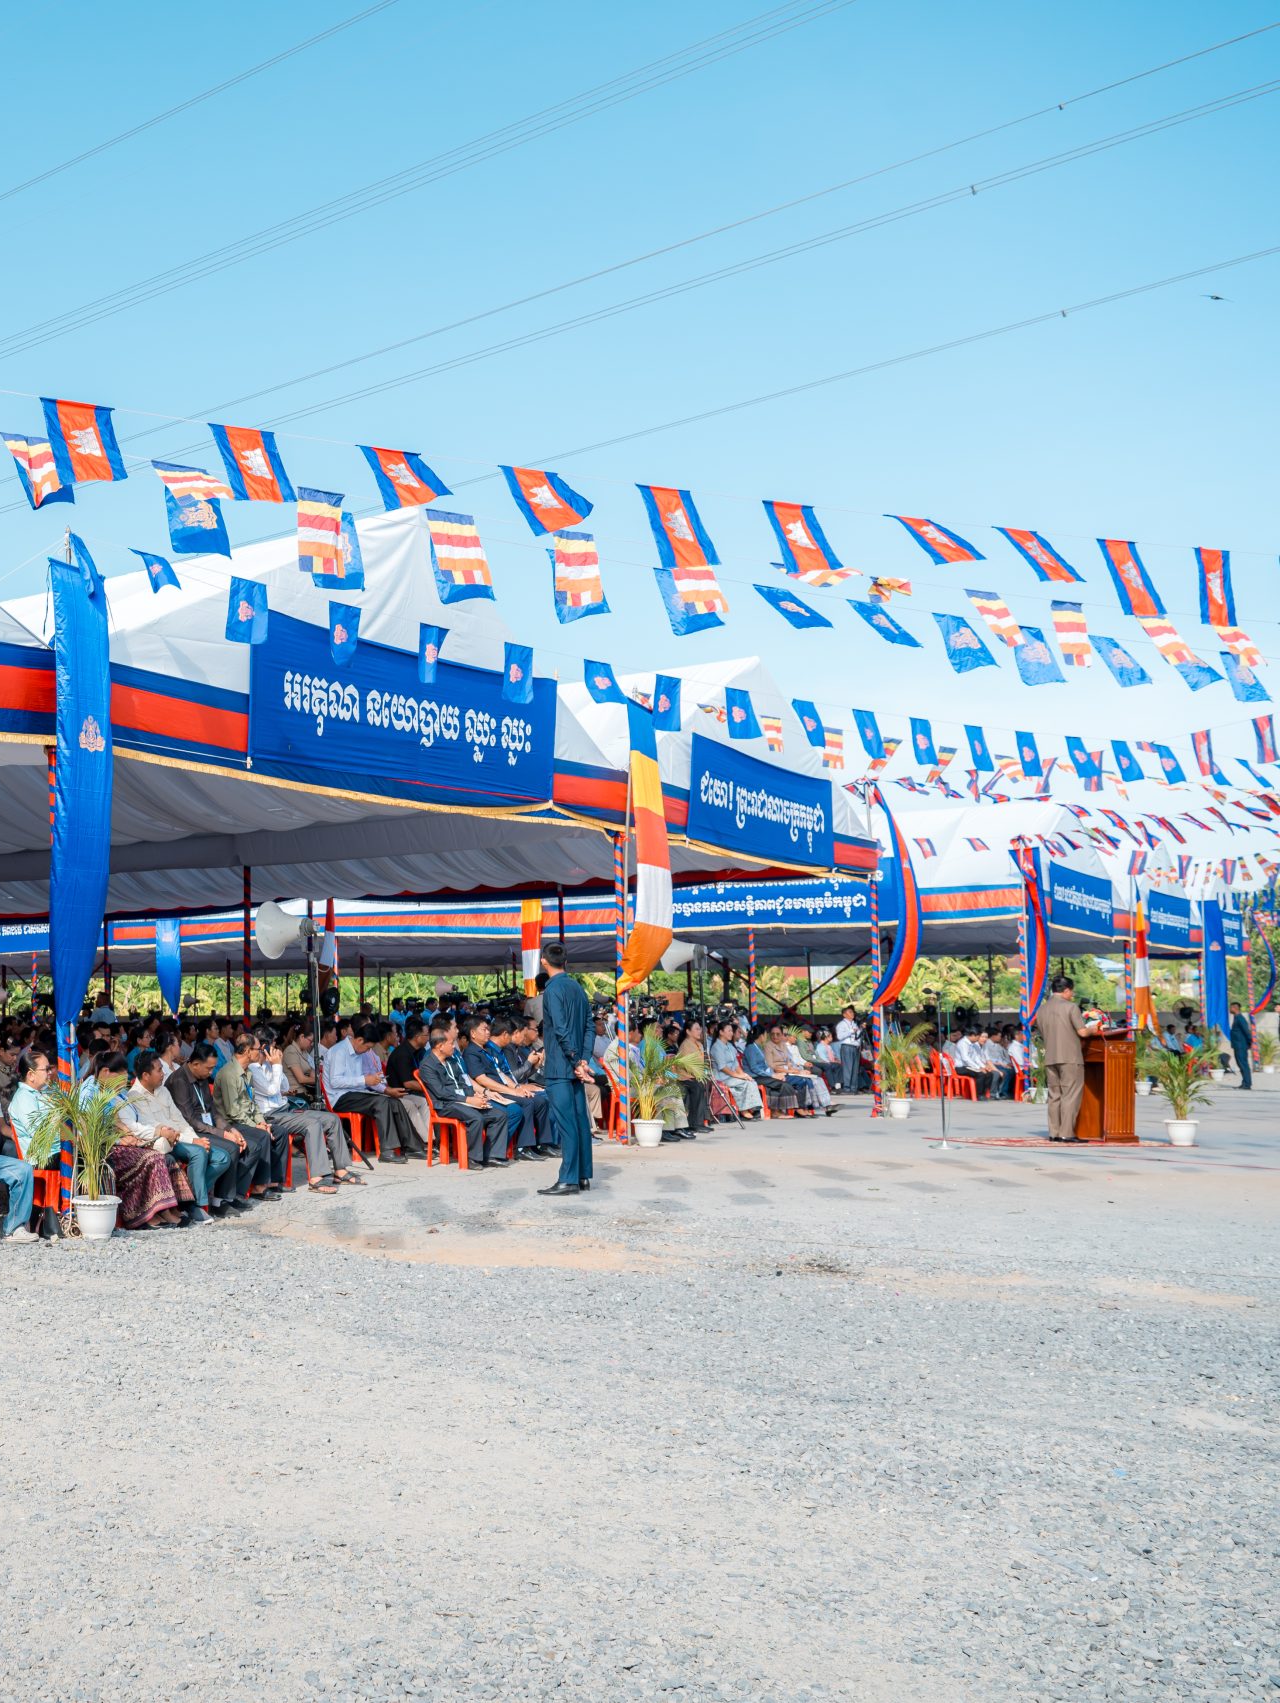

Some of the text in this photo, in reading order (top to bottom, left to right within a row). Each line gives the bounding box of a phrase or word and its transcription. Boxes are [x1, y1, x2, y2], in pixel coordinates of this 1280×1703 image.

[283, 670, 360, 737] អរគុណ
[366, 689, 460, 748] នយោបាយ
[672, 891, 867, 918] លបានកសាងសន្តិភាពជូនមាតុភូមិកម្ពុជា
